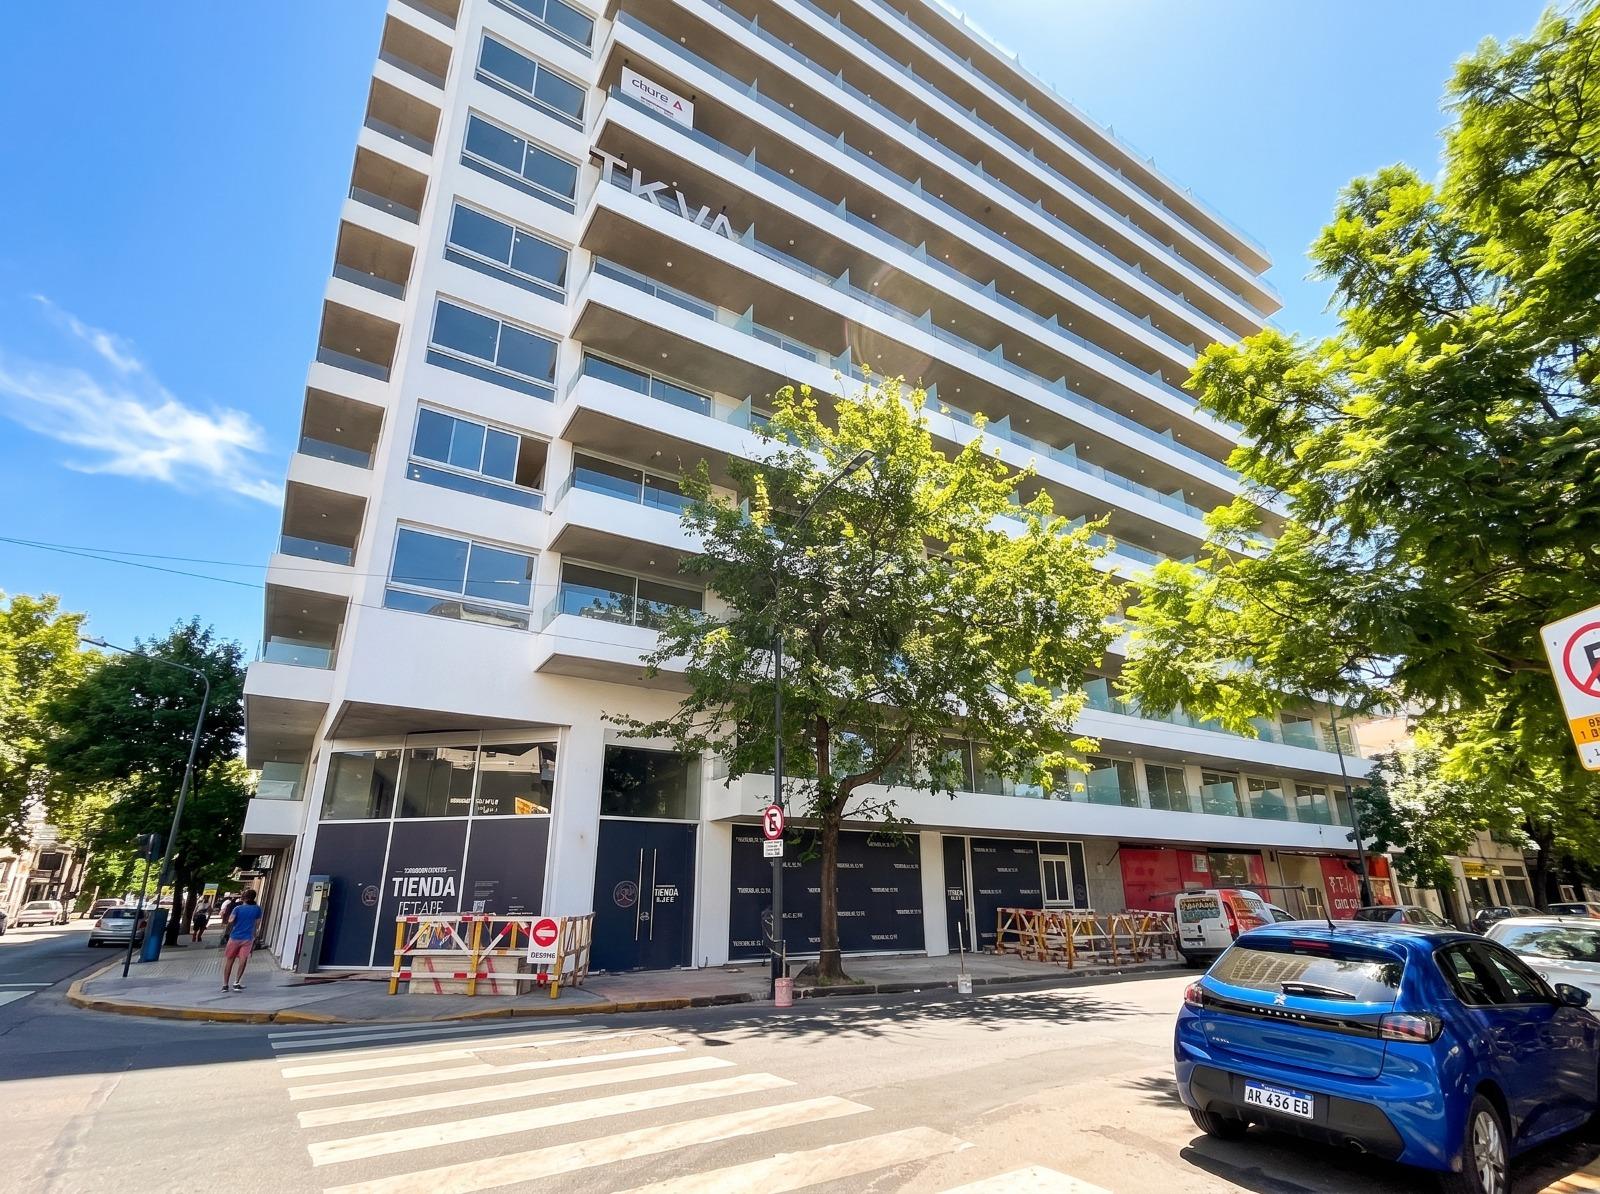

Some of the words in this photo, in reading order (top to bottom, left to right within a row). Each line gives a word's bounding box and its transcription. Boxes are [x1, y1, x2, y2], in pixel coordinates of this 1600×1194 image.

[392, 876, 456, 897] TIENDA
[1247, 1088, 1262, 1104] AR
[1266, 1093, 1290, 1110] 436
[1293, 1100, 1309, 1115] EB
